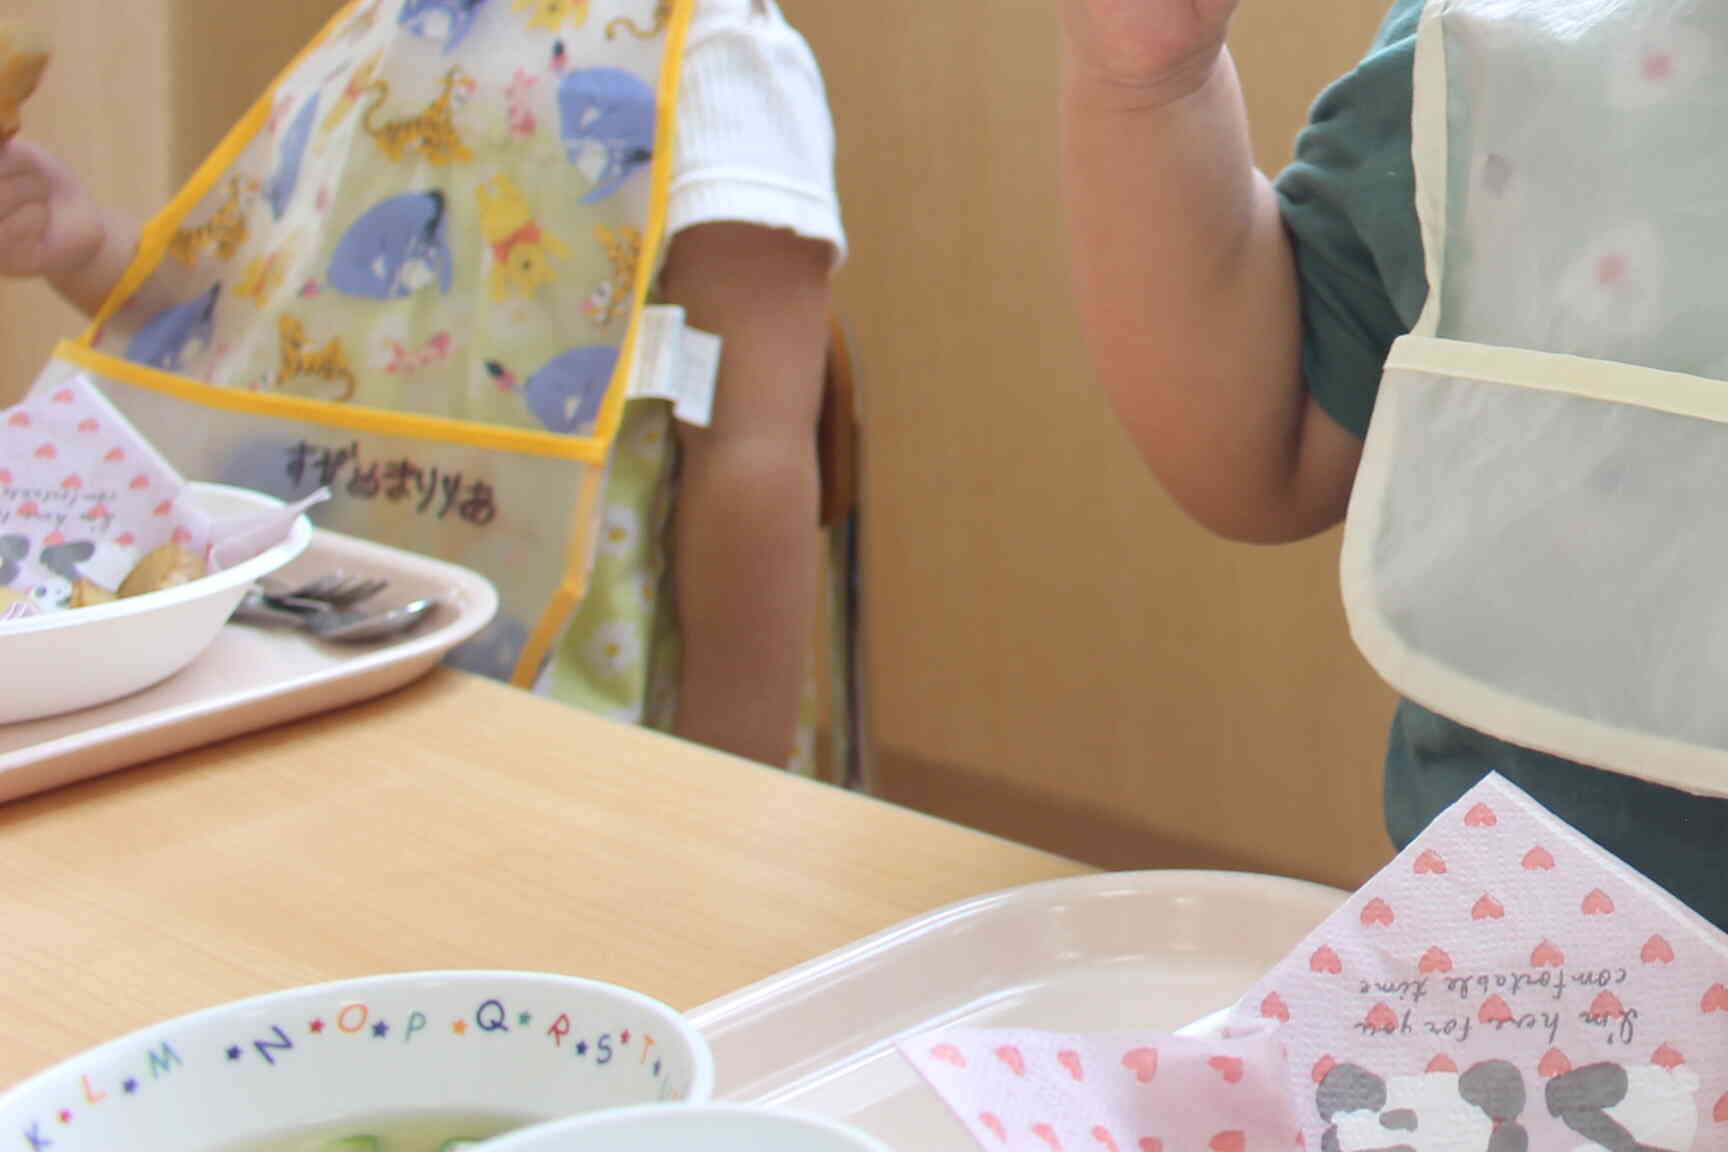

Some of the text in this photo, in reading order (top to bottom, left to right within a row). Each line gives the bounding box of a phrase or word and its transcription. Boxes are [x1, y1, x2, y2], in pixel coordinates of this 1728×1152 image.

[1360, 974, 1429, 1001] time
[1353, 1010, 1413, 1035] you
[1424, 1015, 1471, 1042] for
[1487, 1010, 1561, 1044] here
[24, 1123, 55, 1152] K
[81, 1072, 109, 1104] L
[147, 1040, 184, 1080] M
[253, 1024, 294, 1065] N
[337, 1003, 369, 1034] O
[404, 1011, 427, 1043] P
[476, 999, 509, 1032] Q
[547, 1013, 570, 1048] R
[596, 1033, 613, 1065] S
